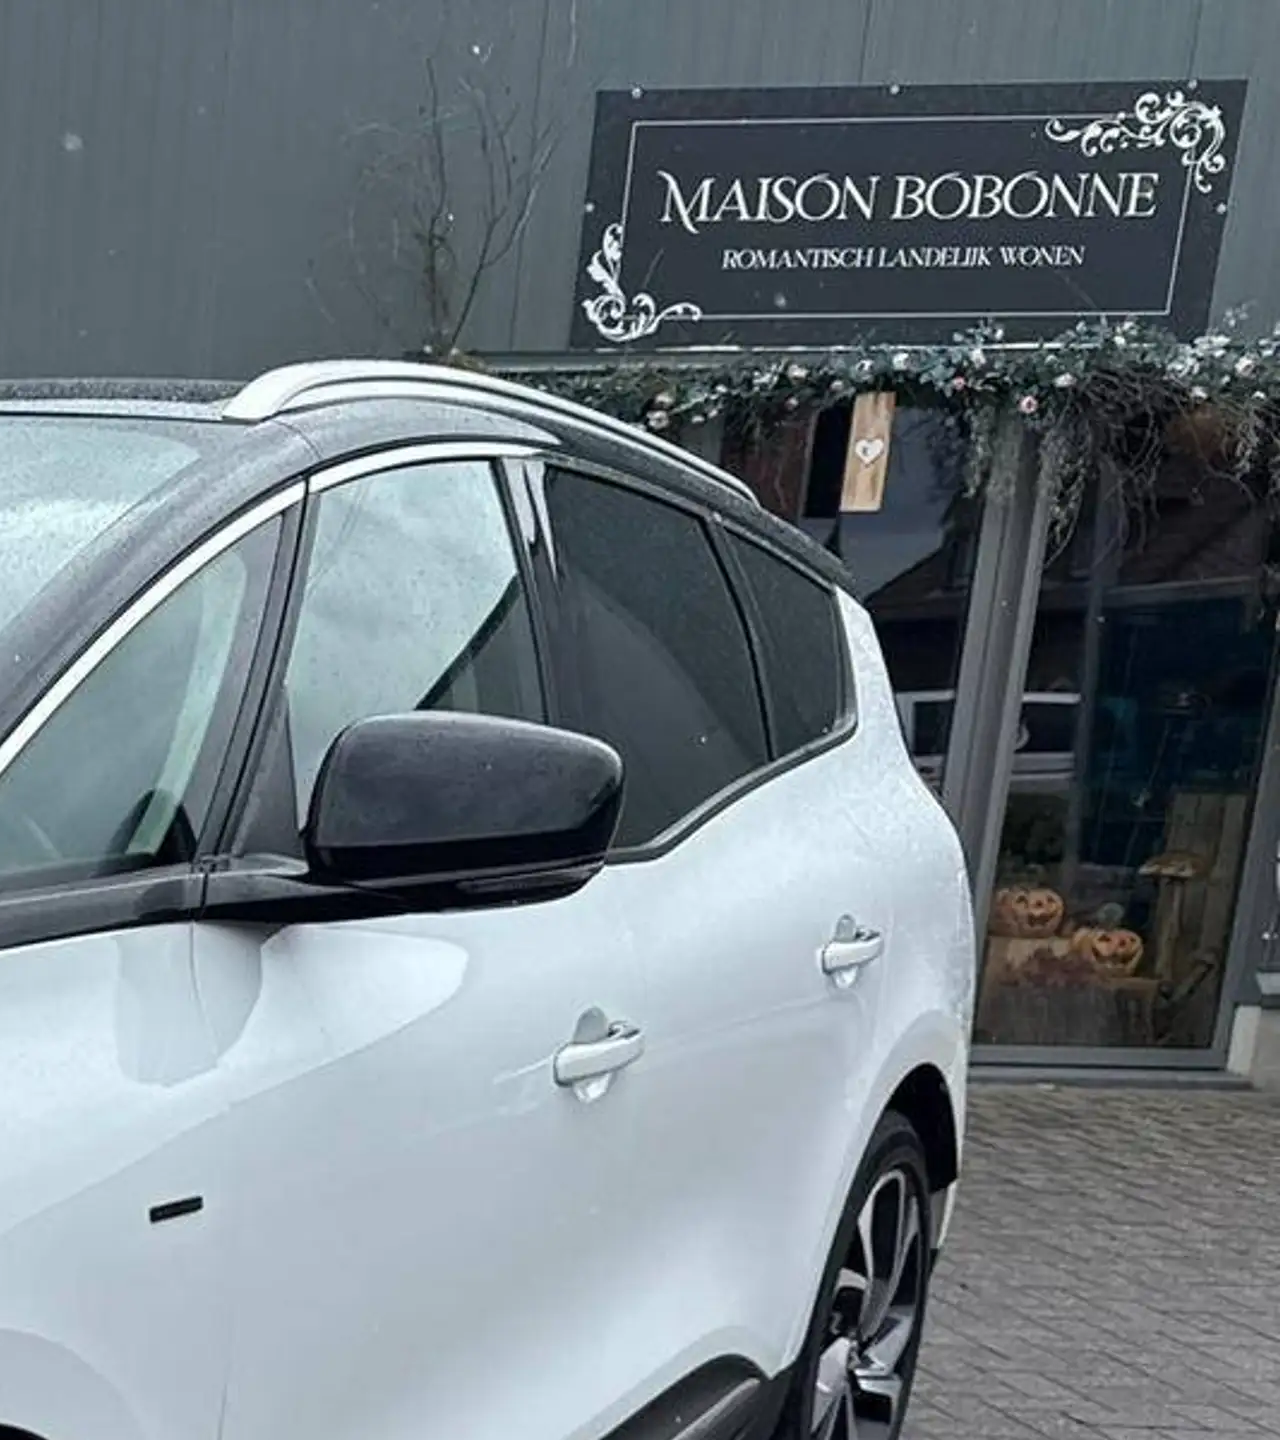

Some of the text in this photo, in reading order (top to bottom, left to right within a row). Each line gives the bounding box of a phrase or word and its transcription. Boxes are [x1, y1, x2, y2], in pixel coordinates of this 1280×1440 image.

[656, 170, 1159, 234] MAISON BOBONNE
[721, 245, 1086, 270] ROMANTISCH LANDELIJK WONEN
